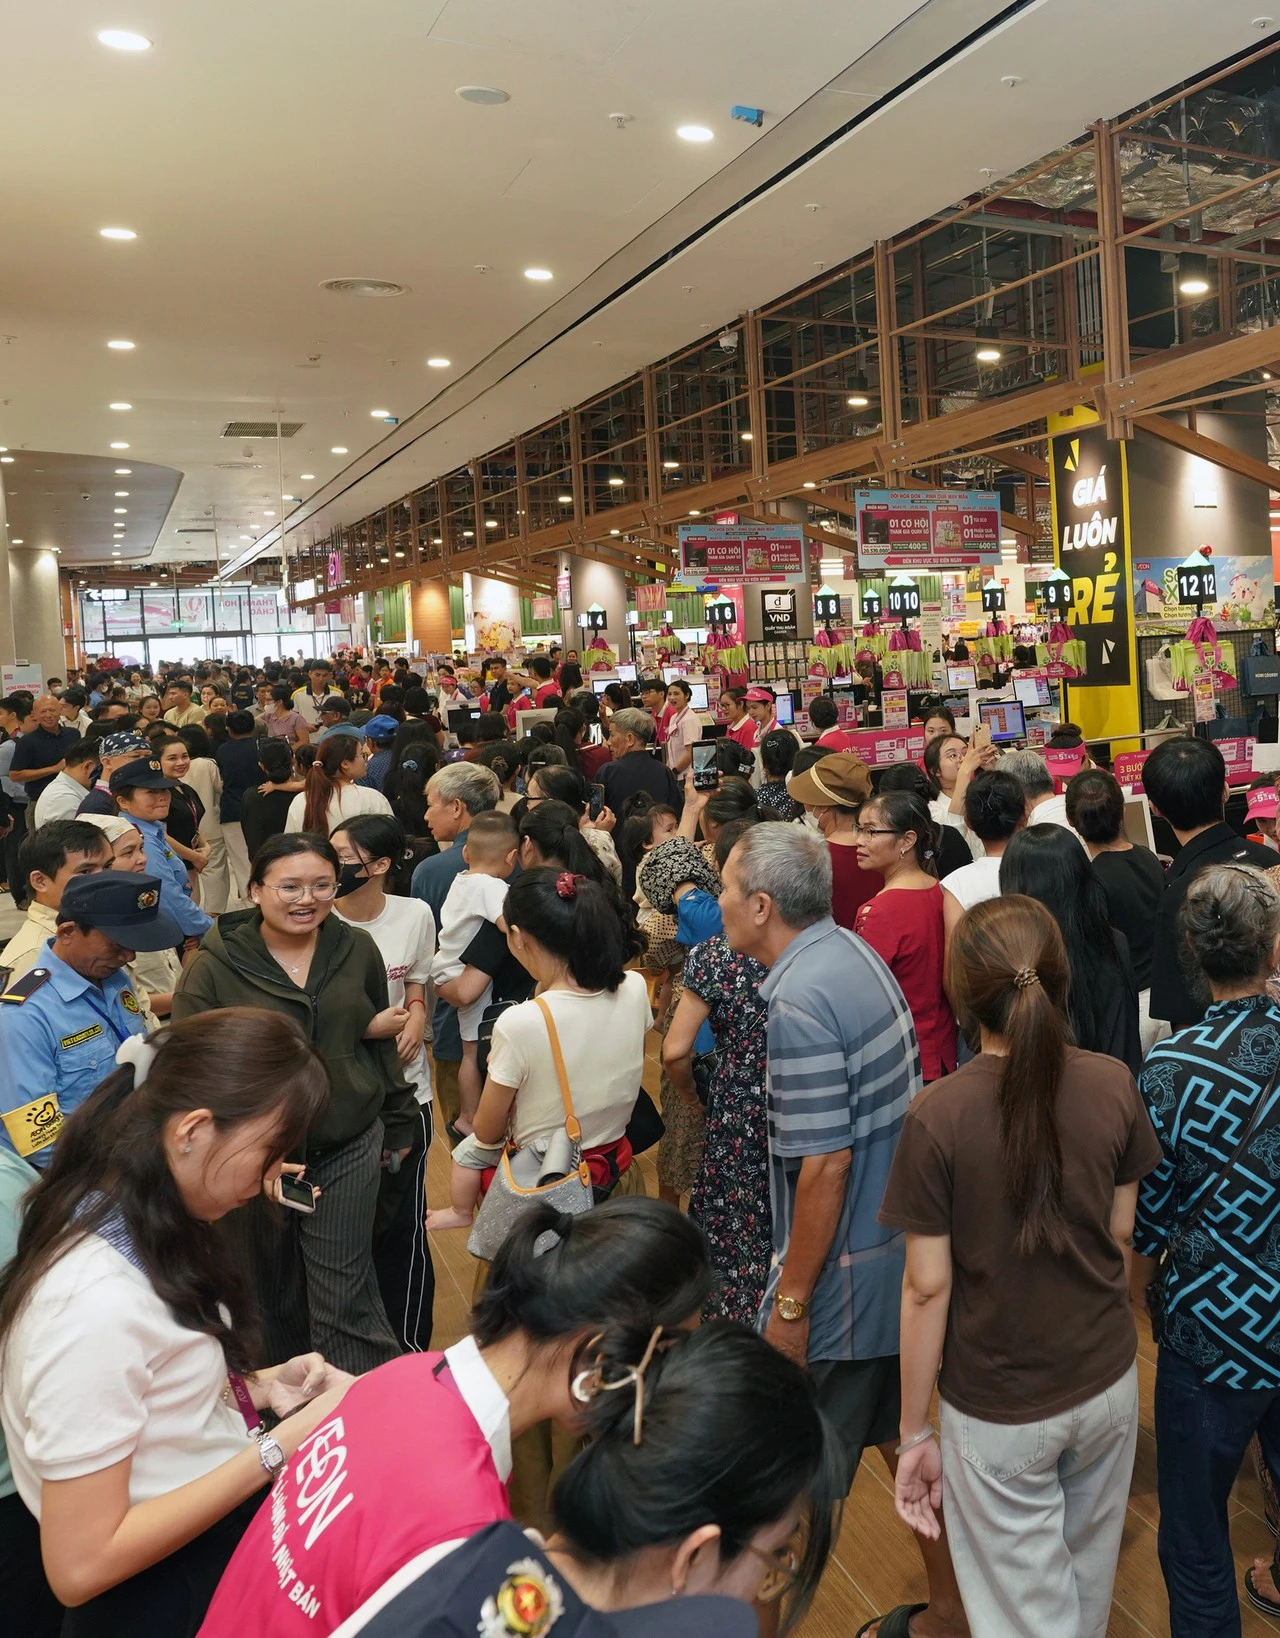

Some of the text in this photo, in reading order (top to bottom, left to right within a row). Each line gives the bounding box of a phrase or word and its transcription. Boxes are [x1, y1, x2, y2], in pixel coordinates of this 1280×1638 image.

[1072, 465, 1107, 508] GIÁ
[889, 519, 899, 528] 01
[914, 518, 929, 529] HỘI
[963, 515, 973, 525] 01
[963, 529, 974, 539] 01
[1062, 512, 1118, 551] LUÔN
[770, 543, 779, 551] 01
[908, 542, 920, 550] 400
[979, 542, 991, 550] 600
[771, 554, 780, 562] 01
[1067, 552, 1121, 626] RẺ
[1180, 575, 1200, 597] 12
[1203, 573, 1215, 596] 12
[903, 591, 919, 610] 10
[984, 593, 990, 607] 7
[996, 592, 1002, 606] 7
[1048, 586, 1056, 603] 9
[1063, 585, 1071, 602] 9
[816, 600, 823, 615] 8
[829, 599, 837, 614] 8
[863, 601, 869, 614] 5
[873, 601, 879, 613] 5
[889, 592, 901, 610] 10
[724, 606, 732, 620] 6
[769, 614, 791, 622] VND
[1120, 761, 1143, 774] 3 BƯỚ
[297, 1416, 354, 1551] AEON
[288, 1579, 321, 1620] BẢN
